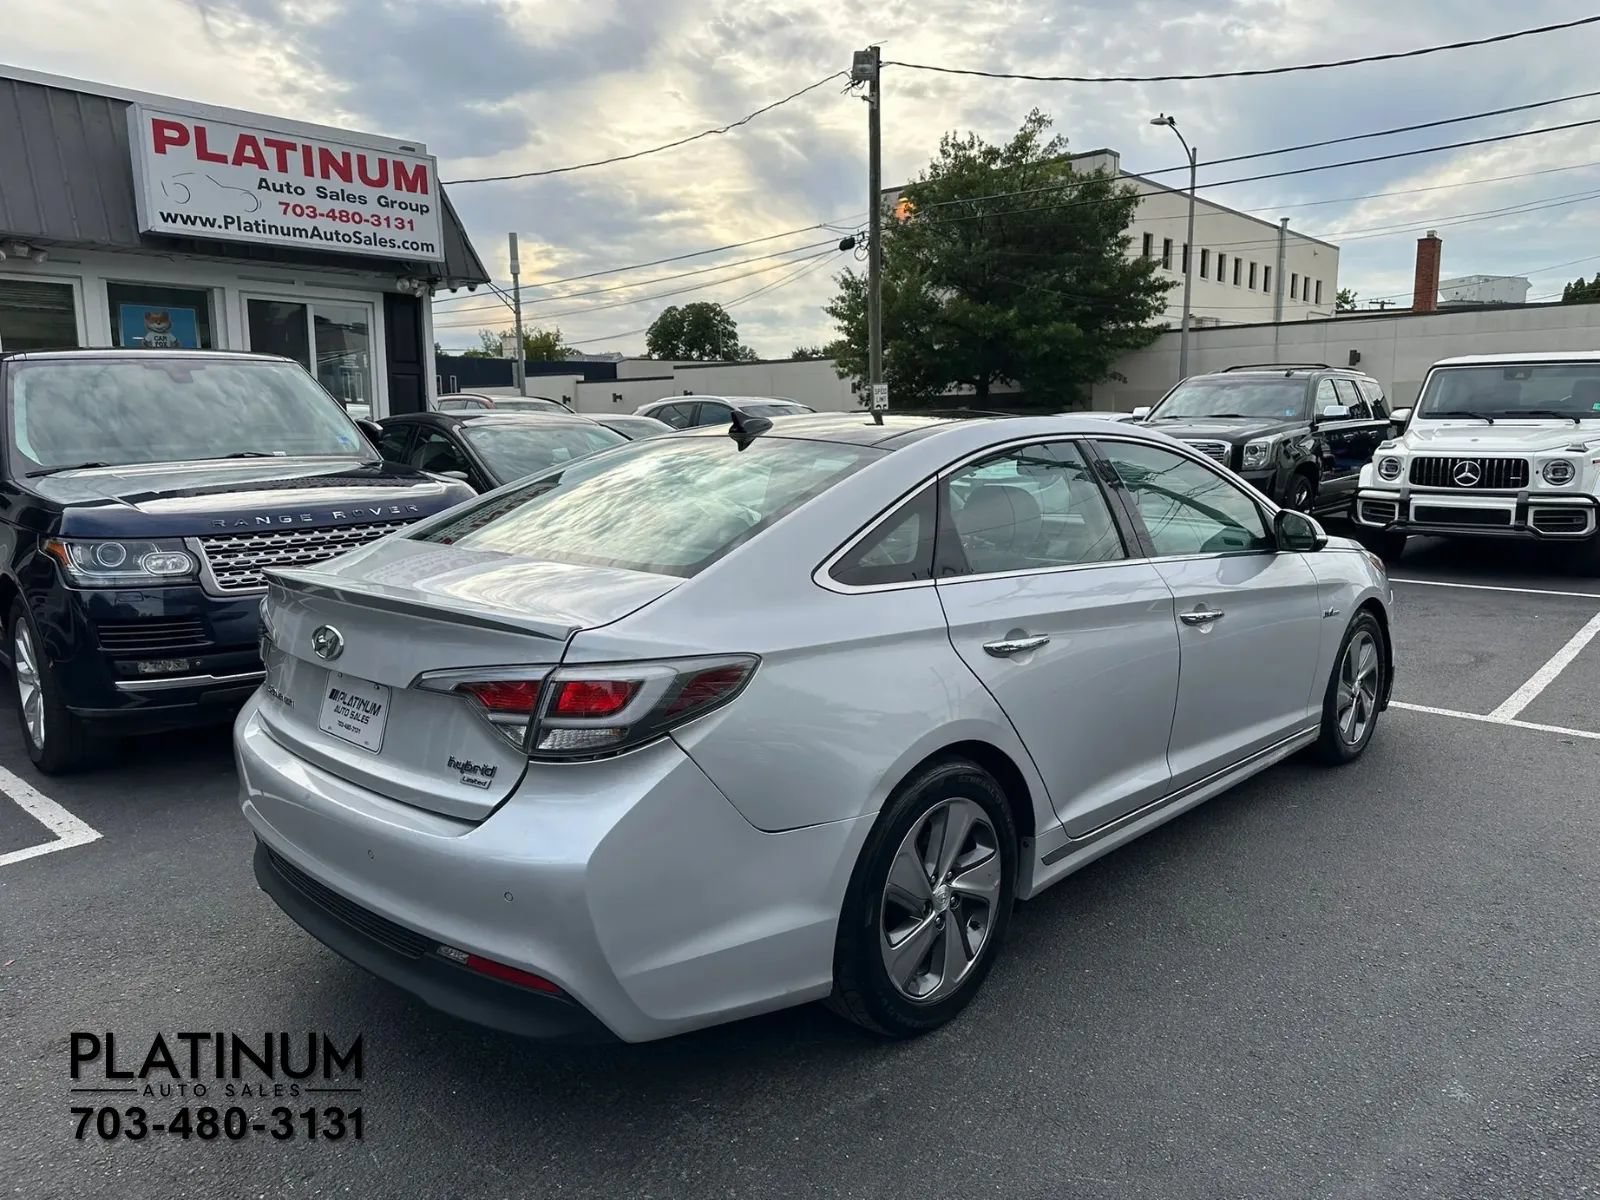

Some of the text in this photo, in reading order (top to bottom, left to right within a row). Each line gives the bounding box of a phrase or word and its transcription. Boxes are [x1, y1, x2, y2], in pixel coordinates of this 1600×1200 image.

[151, 117, 429, 195] PLATINUM
[257, 177, 430, 216] Auto Sales Group
[278, 201, 416, 232] 703-480-3131
[159, 210, 435, 253] www.PlatinumAutoSales.com
[211, 504, 419, 528] RANGE ROVER
[333, 704, 371, 725] AUTO SALES
[340, 692, 381, 716] PLATINUM
[447, 755, 497, 777] hybrid
